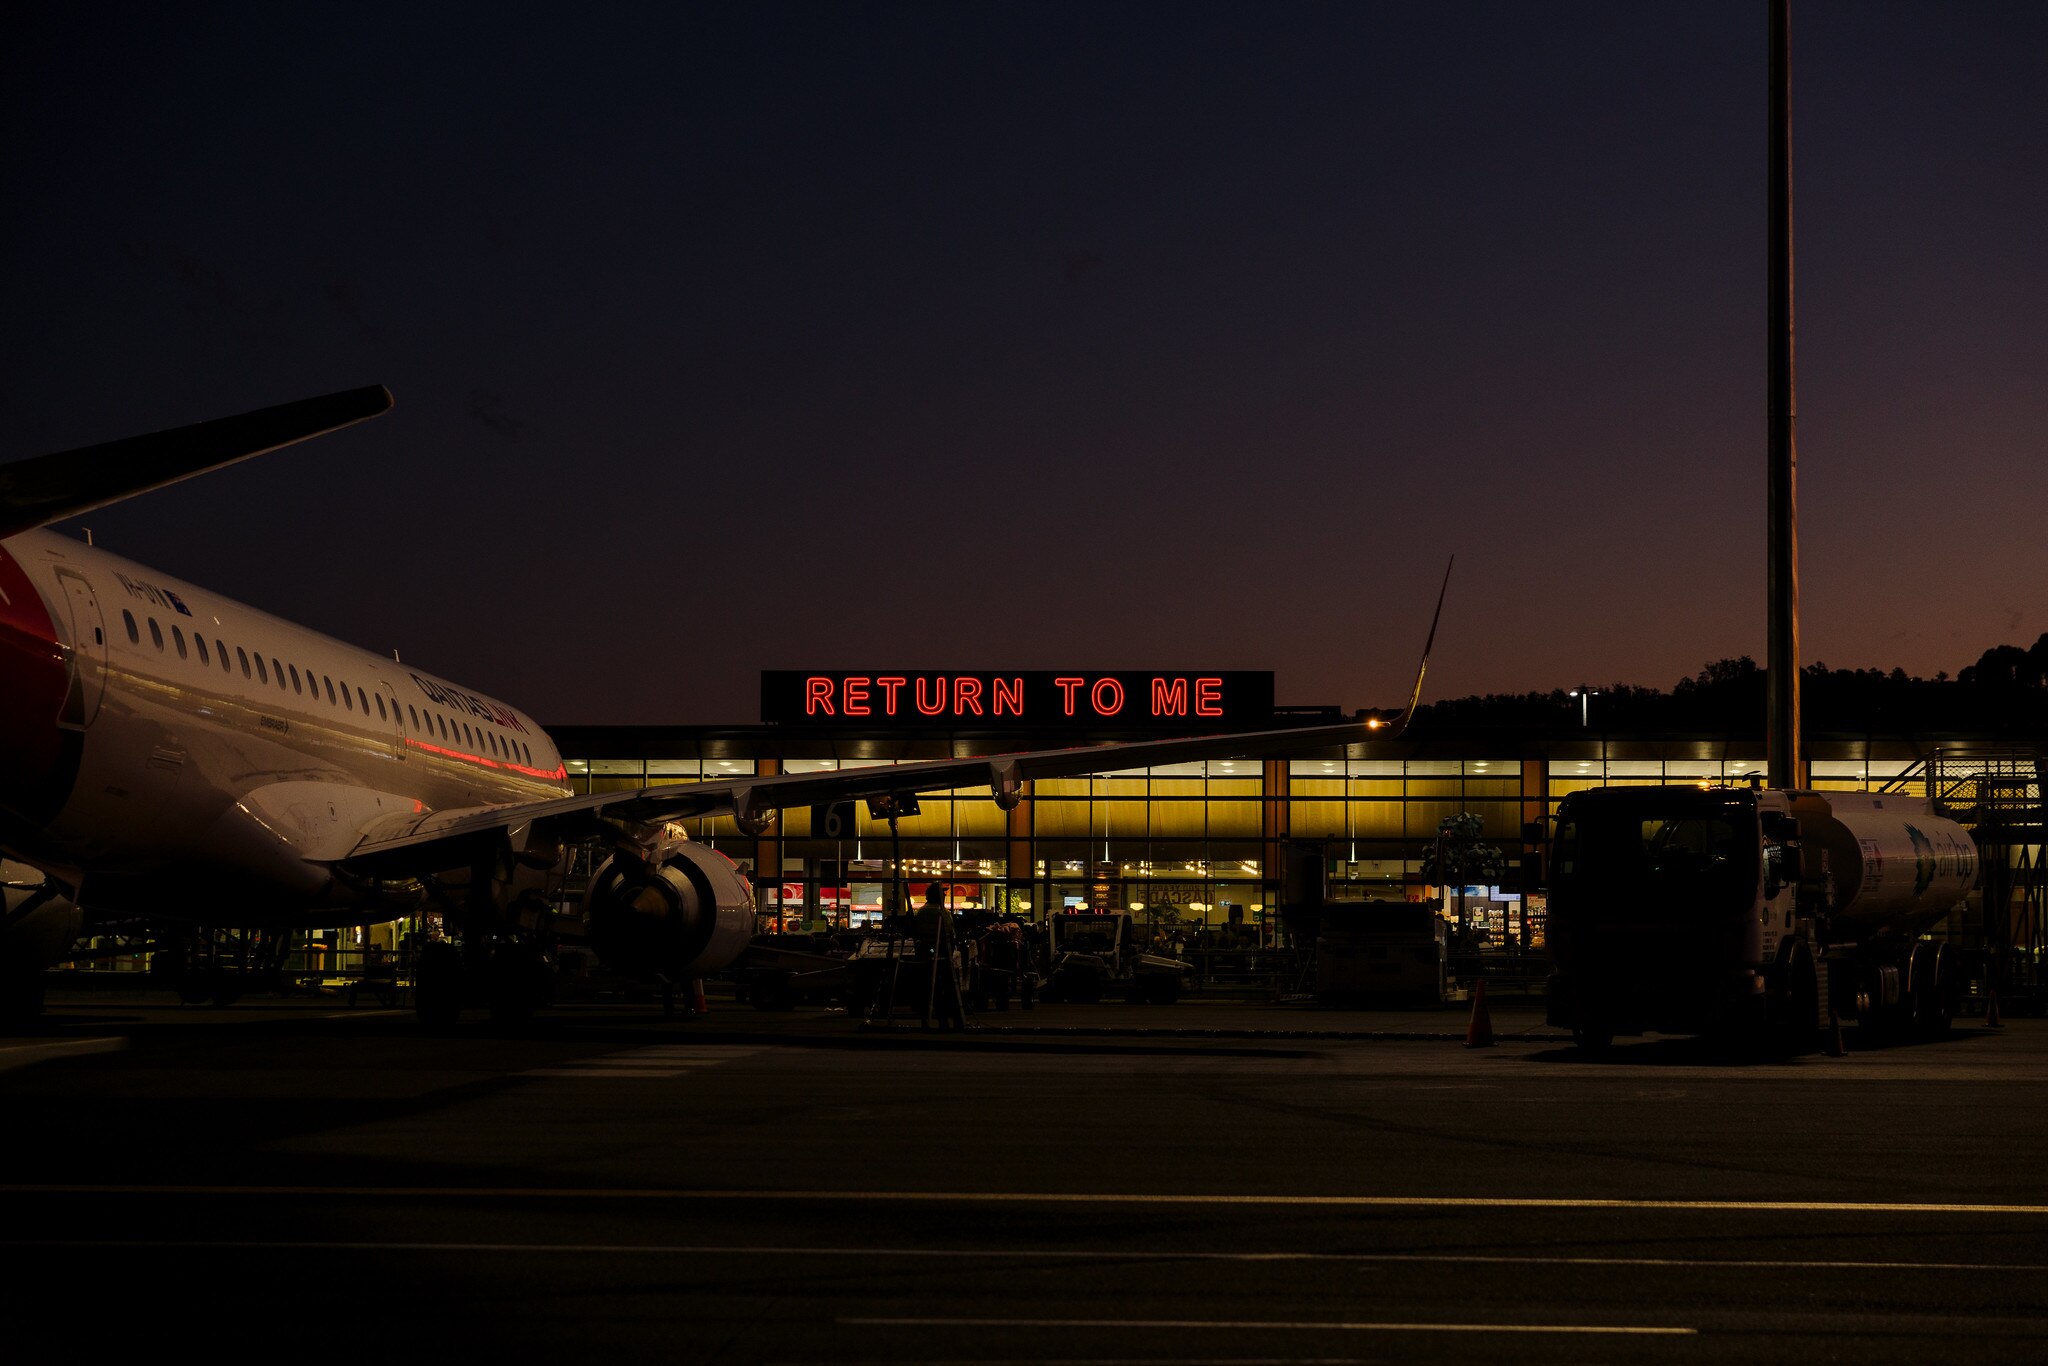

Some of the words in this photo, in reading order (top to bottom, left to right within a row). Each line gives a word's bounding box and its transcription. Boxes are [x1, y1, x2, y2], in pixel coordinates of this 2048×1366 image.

[805, 676, 1026, 718] RETURN
[1055, 677, 1125, 718] TO
[1151, 677, 1224, 718] ME
[824, 802, 842, 838] 6
[1938, 830, 1954, 878] air
[1947, 832, 1974, 888] bp
